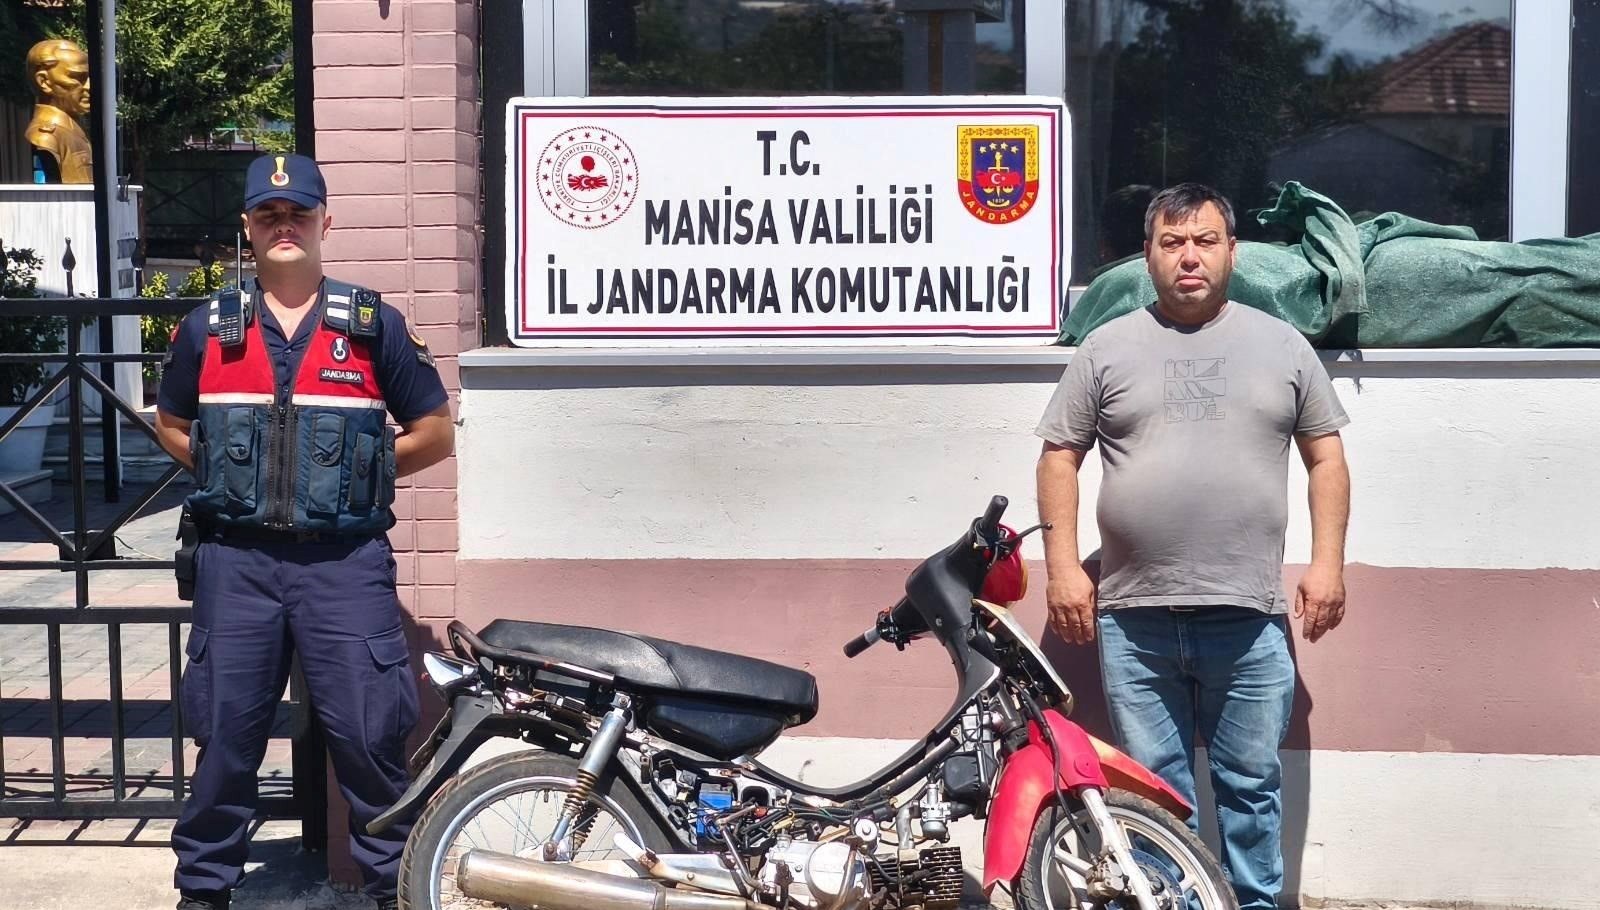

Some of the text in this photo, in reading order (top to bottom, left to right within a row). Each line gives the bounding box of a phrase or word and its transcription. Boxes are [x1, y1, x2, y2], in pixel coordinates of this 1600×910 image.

[757, 131, 819, 175] T.C.
[646, 185, 932, 245] MANİSA VALİLİĞİ
[962, 191, 1035, 221] JANDARMA
[548, 255, 1029, 314] İL JANDARMA KOMUTANLIĞI
[321, 368, 362, 381] JANDARMA
